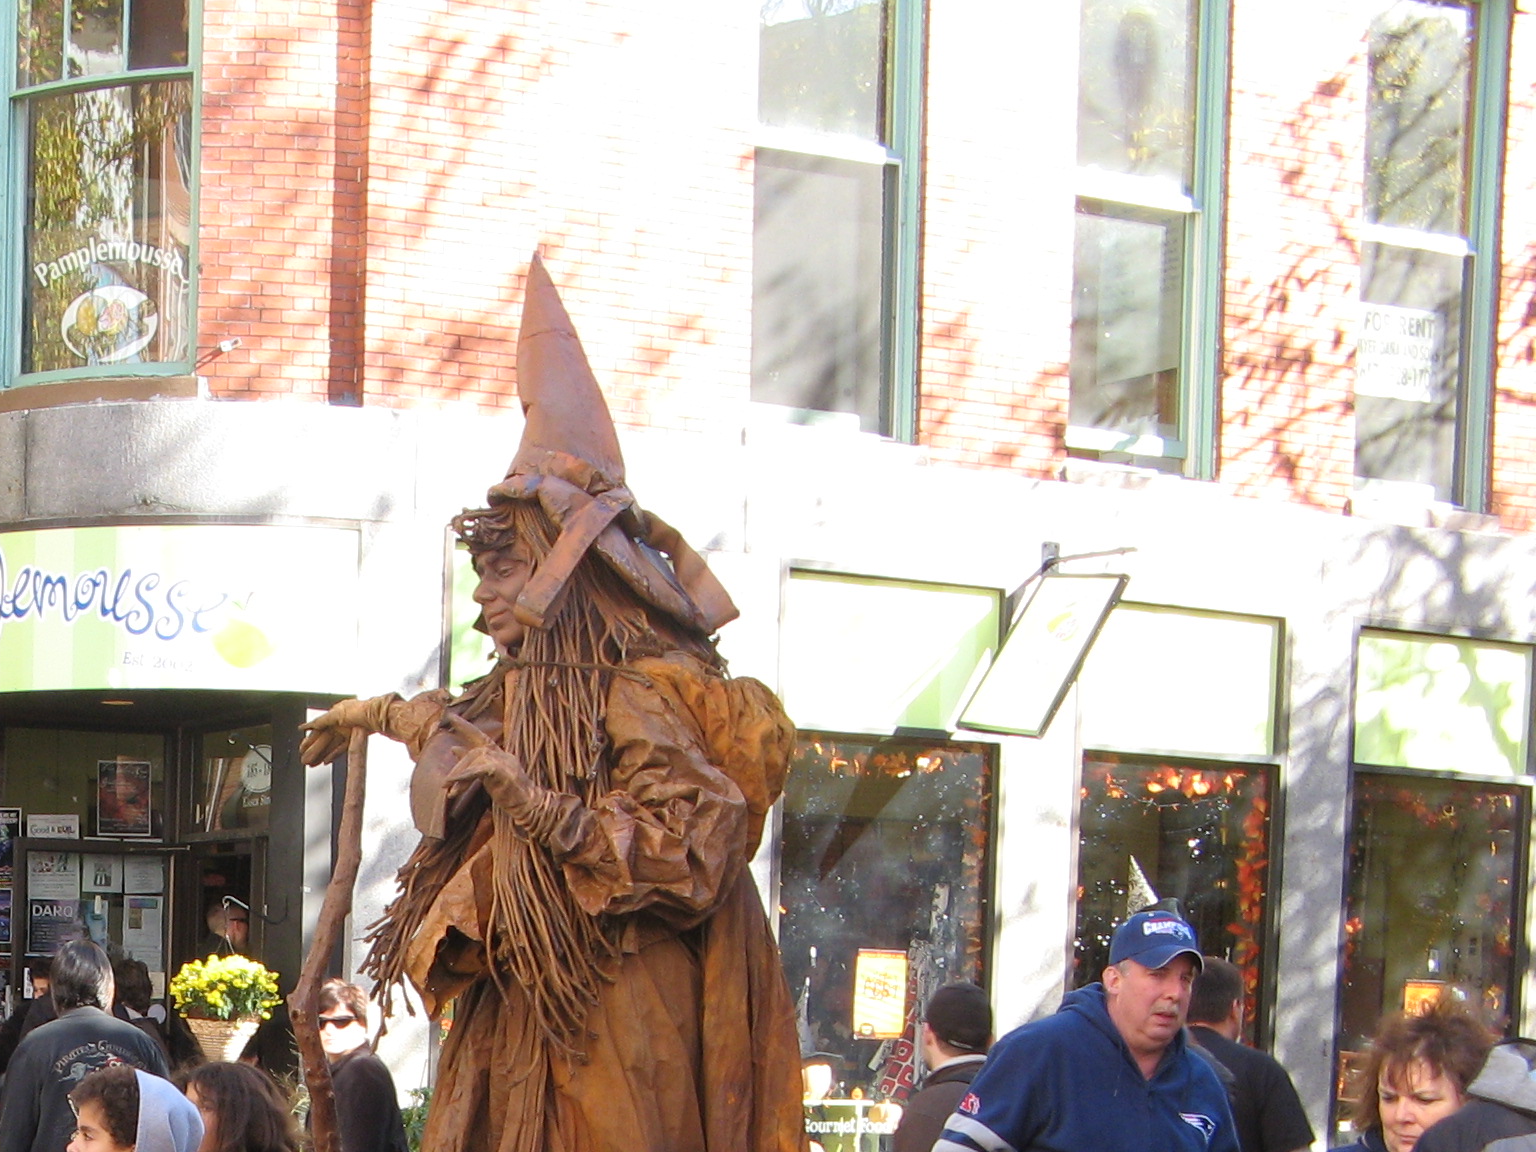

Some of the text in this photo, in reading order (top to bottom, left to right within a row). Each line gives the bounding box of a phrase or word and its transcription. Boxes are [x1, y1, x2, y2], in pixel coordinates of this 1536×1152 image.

[33, 236, 189, 288] Pamplemousse
[1364, 312, 1436, 339] FOR RENT
